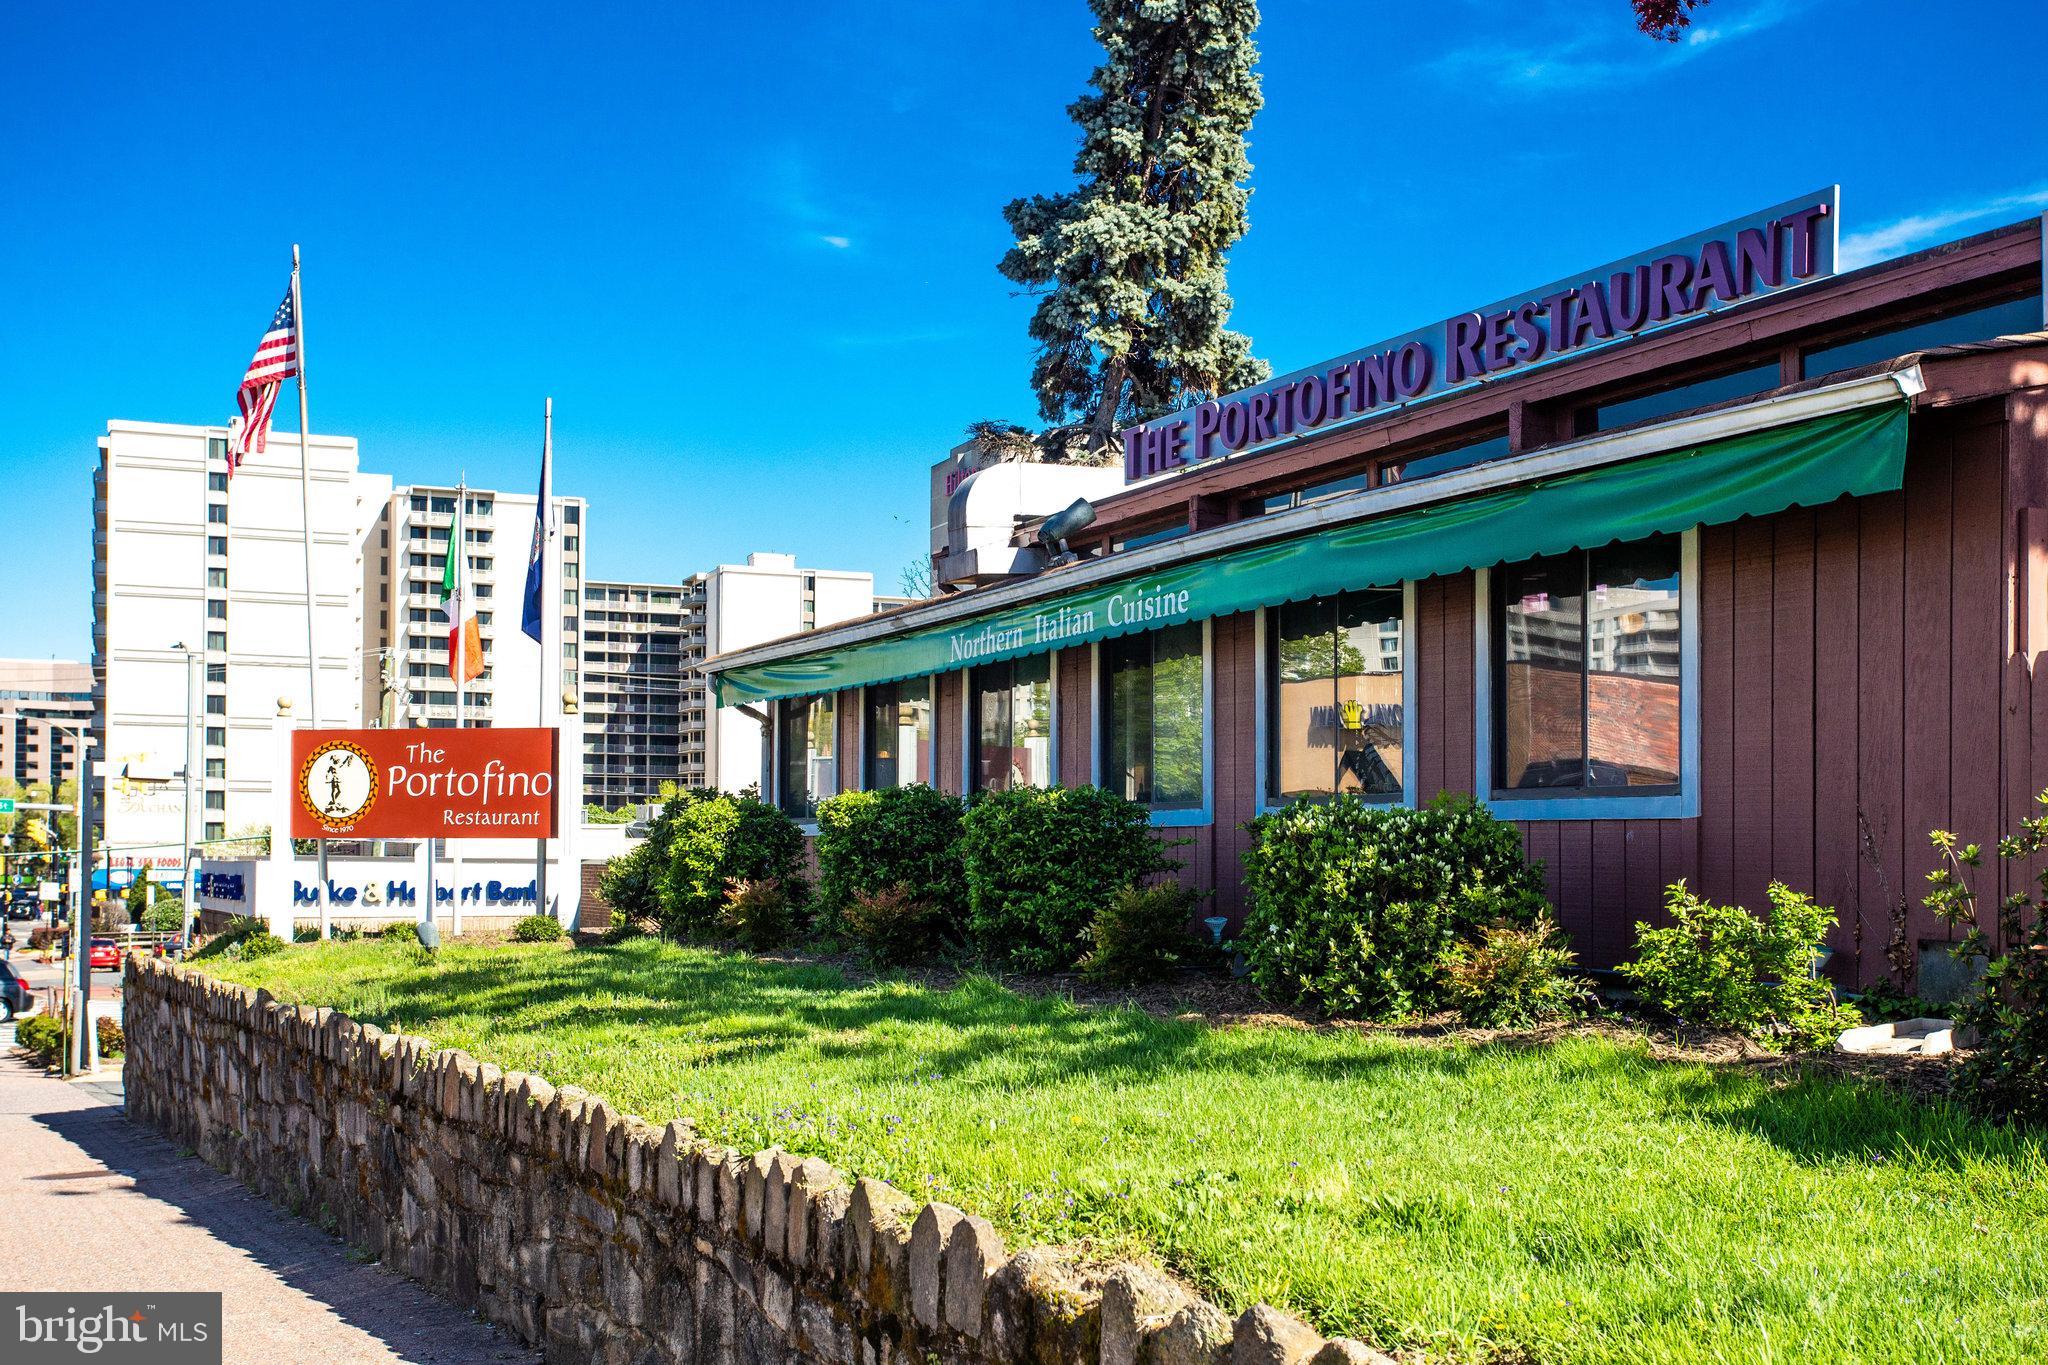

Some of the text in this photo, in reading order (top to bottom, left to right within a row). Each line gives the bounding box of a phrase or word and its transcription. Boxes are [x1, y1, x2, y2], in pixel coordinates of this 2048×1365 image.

[1121, 204, 1827, 480] THE PORTOFINO RESTAURANT
[950, 584, 1189, 663] Northern Italian Cuisine
[406, 742, 445, 764] The
[388, 760, 552, 805] Portofino
[443, 809, 540, 825] Restaurant
[321, 824, 339, 834] Since
[110, 857, 135, 867] LEGL
[157, 857, 182, 867] FOODS
[294, 879, 357, 901] Buke
[364, 881, 382, 902] &
[387, 879, 482, 901] Hebrt
